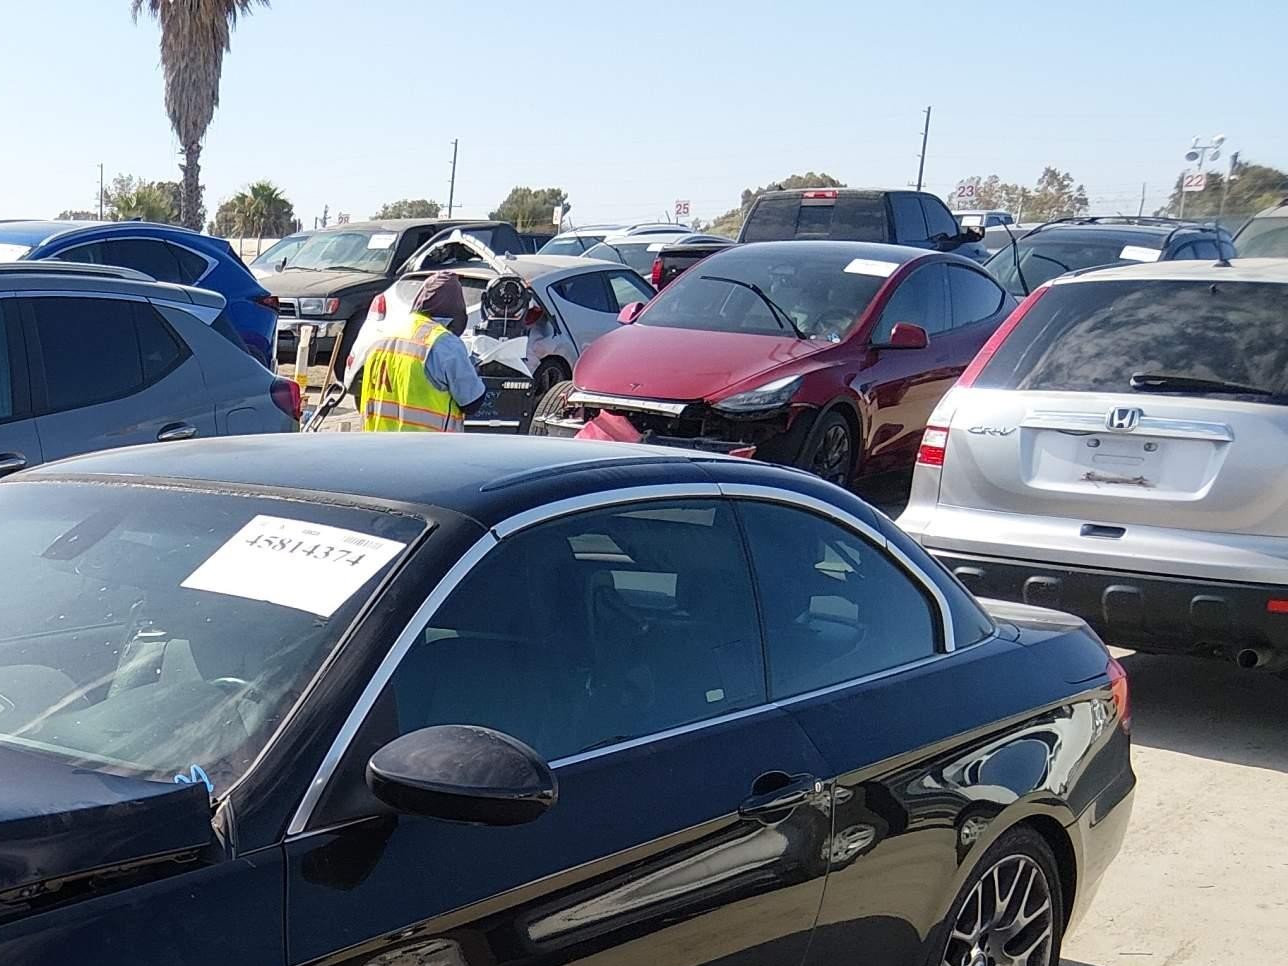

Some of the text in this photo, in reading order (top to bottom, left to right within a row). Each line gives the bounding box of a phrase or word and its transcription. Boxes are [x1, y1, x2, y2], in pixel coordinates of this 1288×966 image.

[1184, 174, 1203, 187] 22
[958, 185, 974, 198] 23
[675, 202, 689, 215] 25
[245, 534, 367, 566] 45814374
